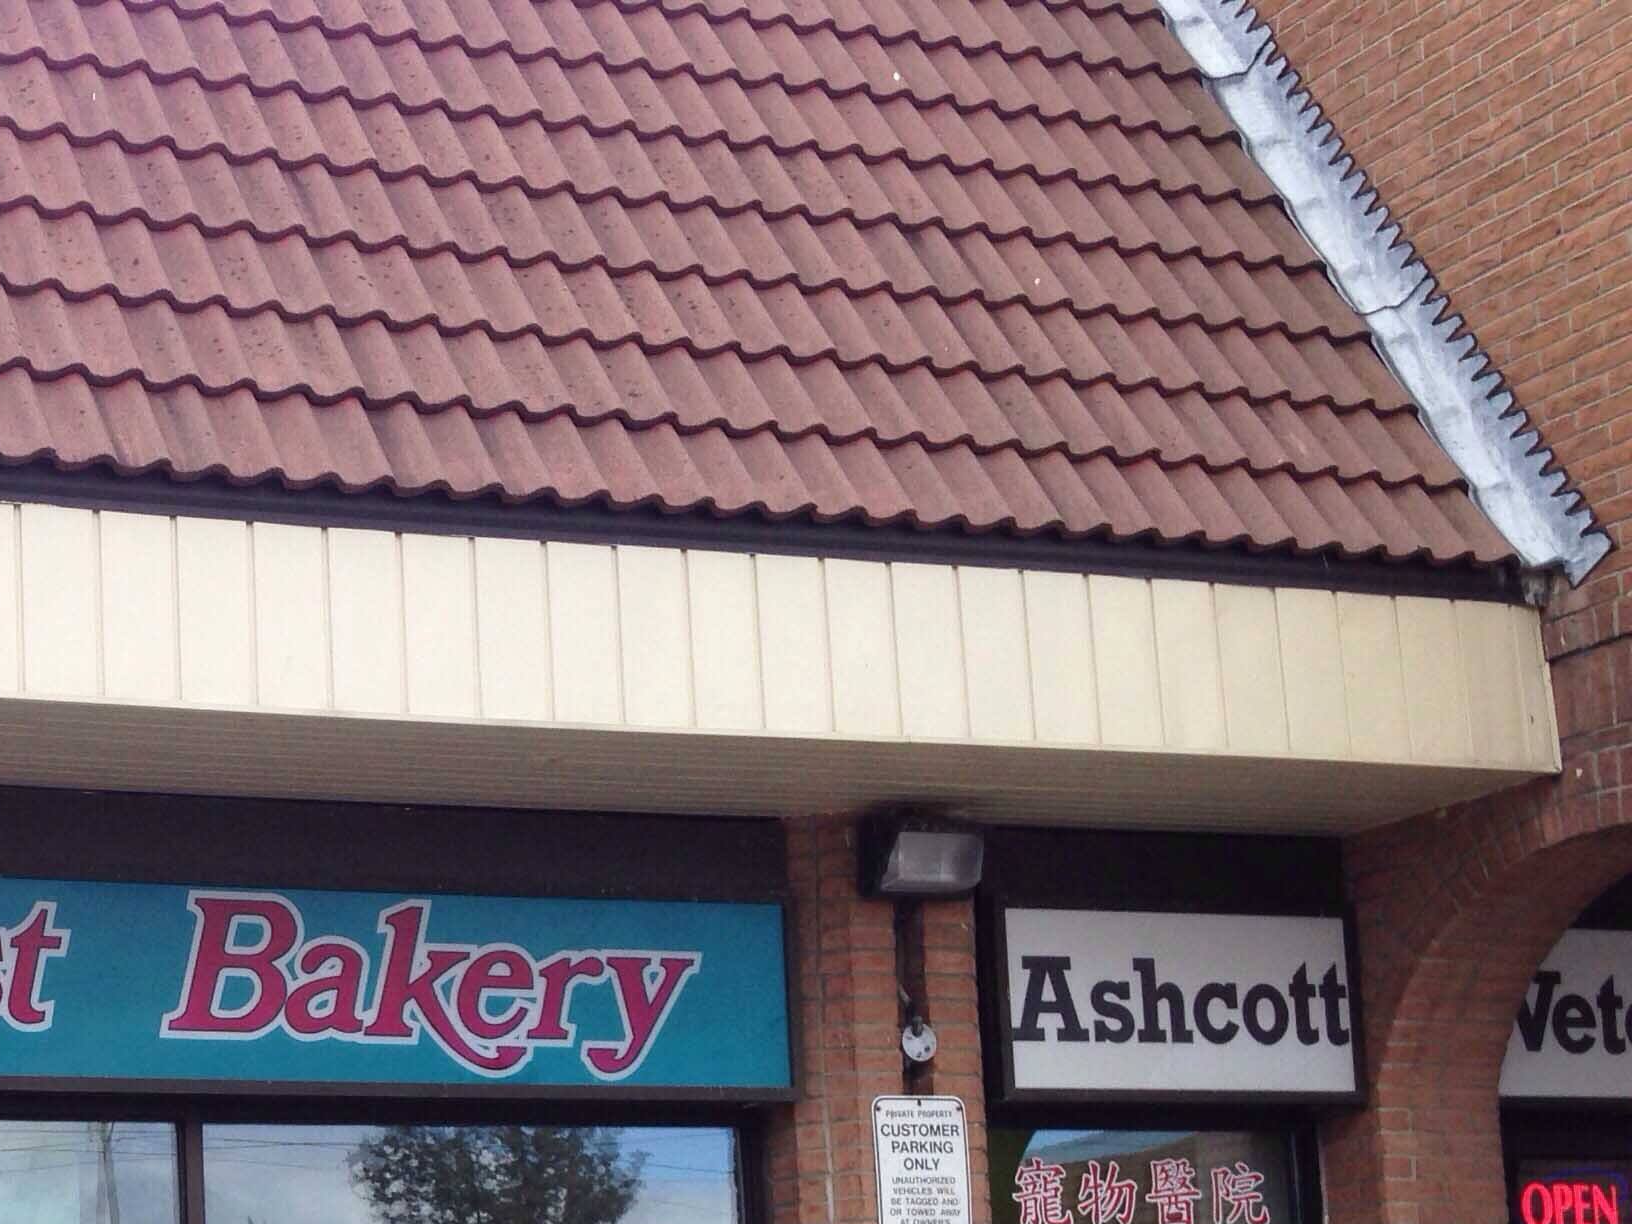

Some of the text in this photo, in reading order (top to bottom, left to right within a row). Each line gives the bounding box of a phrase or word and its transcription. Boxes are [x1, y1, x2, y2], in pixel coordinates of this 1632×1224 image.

[160, 887, 701, 1080] Bakery
[1012, 955, 1350, 1047] Ashcott
[1515, 970, 1632, 1057] Vet
[885, 1110, 952, 1119] PRIVATE PROPERTY
[880, 1123, 960, 1137] CUSTOMER
[891, 1140, 954, 1154] PARKING
[903, 1157, 941, 1170] ONLY
[892, 1176, 956, 1184] UNAUTHORIZED
[893, 1187, 933, 1195] VEHICLES
[907, 1208, 936, 1216] TOWED
